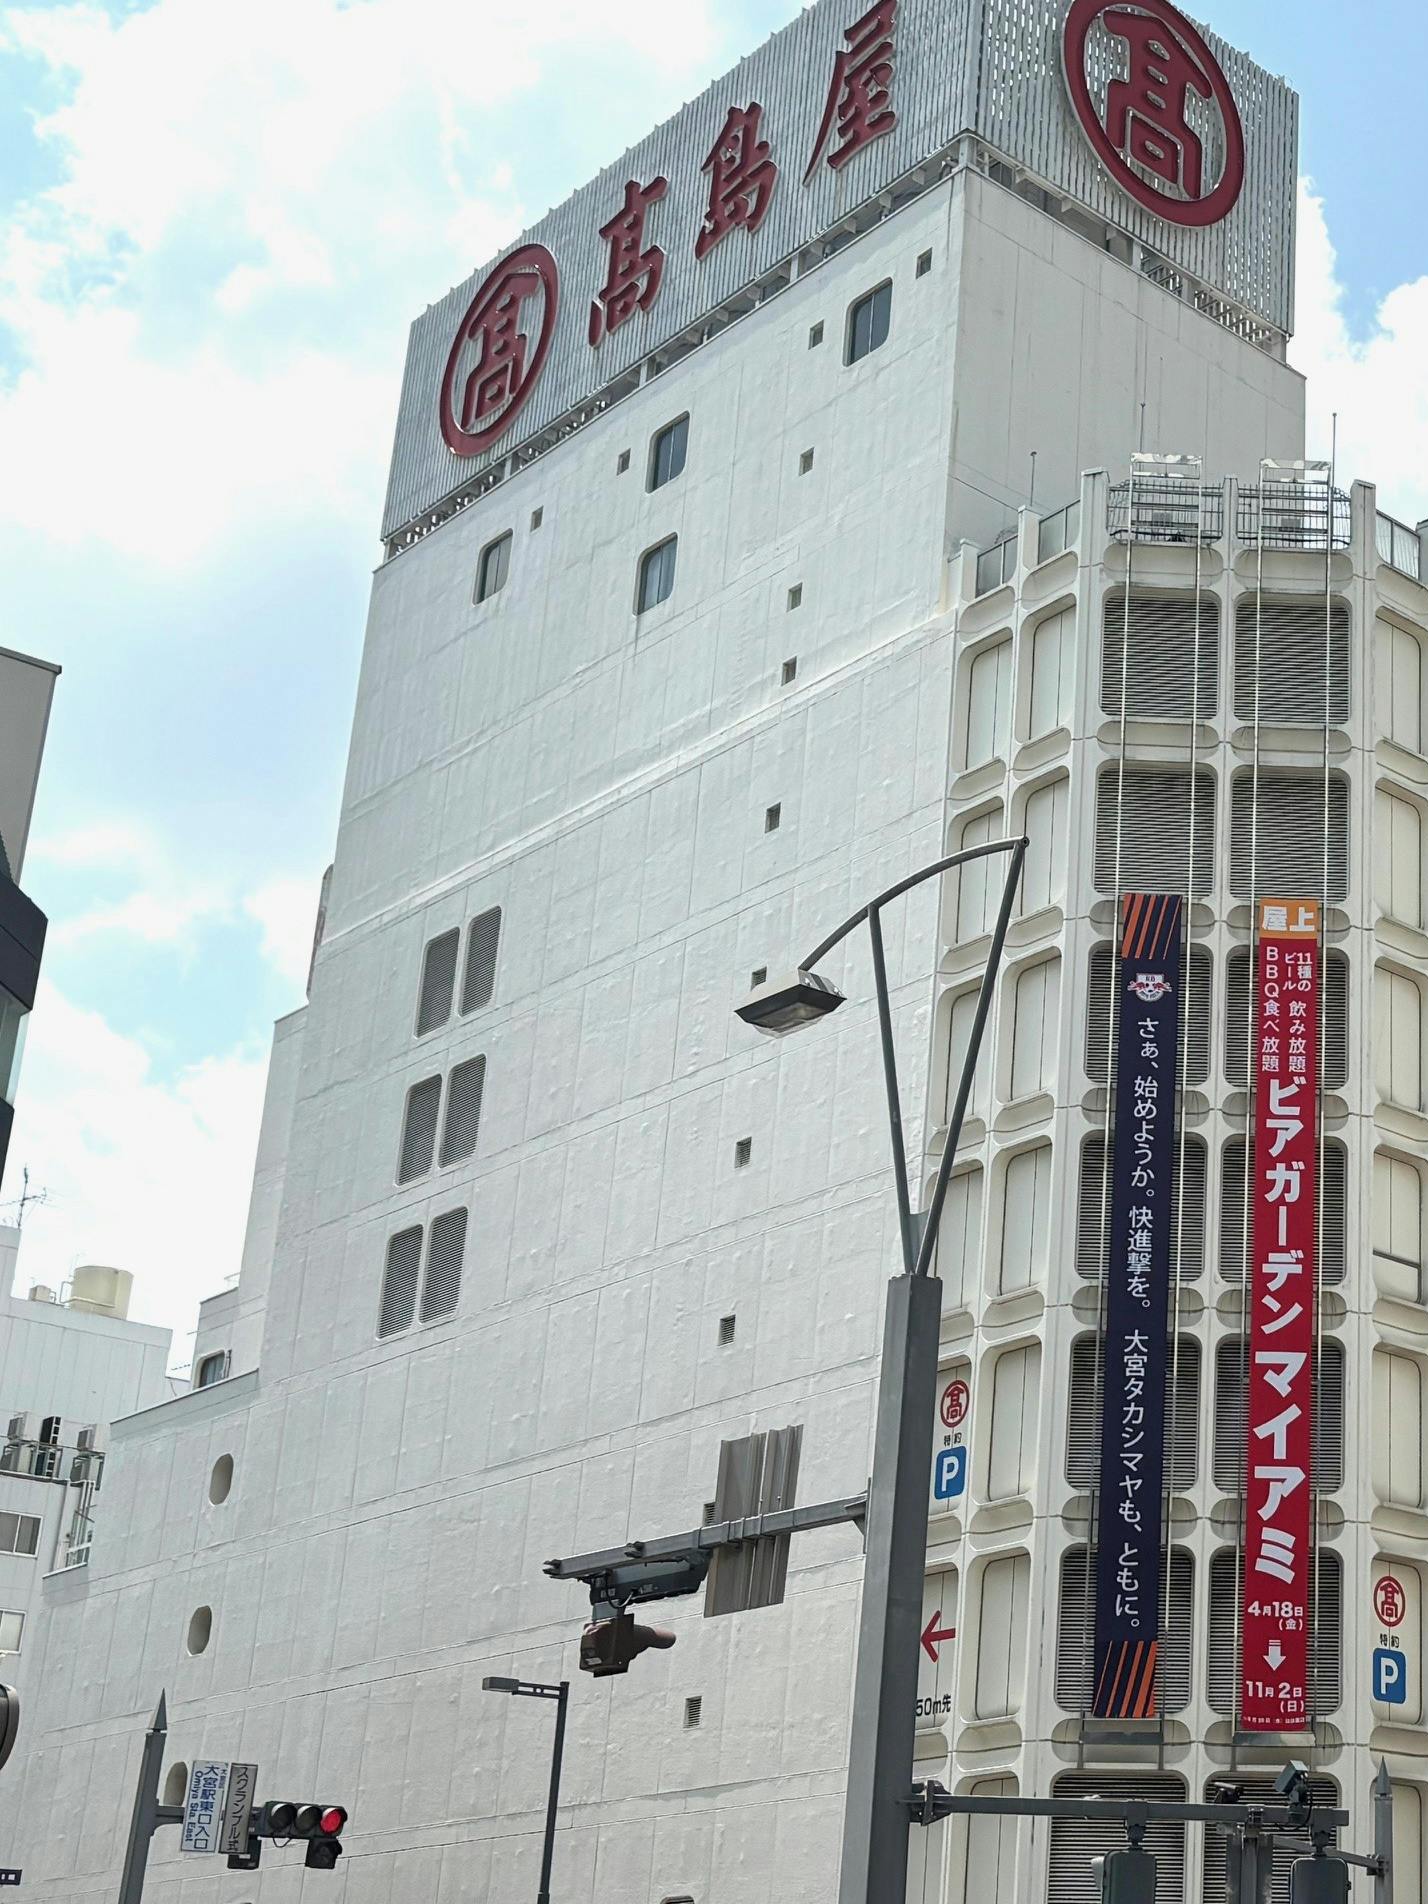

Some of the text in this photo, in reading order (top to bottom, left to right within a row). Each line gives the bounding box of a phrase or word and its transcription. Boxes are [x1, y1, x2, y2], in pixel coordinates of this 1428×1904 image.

[1262, 906, 1315, 932] 屋上
[1283, 952, 1297, 991] ビール
[1297, 952, 1313, 992] 11種の
[1262, 946, 1280, 1072] BBQ食べ放題
[1288, 1001, 1307, 1073] 飲み放題
[1253, 1075, 1308, 1585] ビアガーデン マイアミ
[941, 1456, 959, 1492] P
[1247, 1600, 1304, 1617] 4月18日
[1380, 1633, 1400, 1648] 特約
[1381, 1657, 1399, 1695] P
[190, 1770, 204, 1799] Omiya
[194, 1765, 220, 1849] 大宮駅東口入口
[227, 1766, 249, 1852] スクランブル式
[185, 1822, 197, 1842] East
